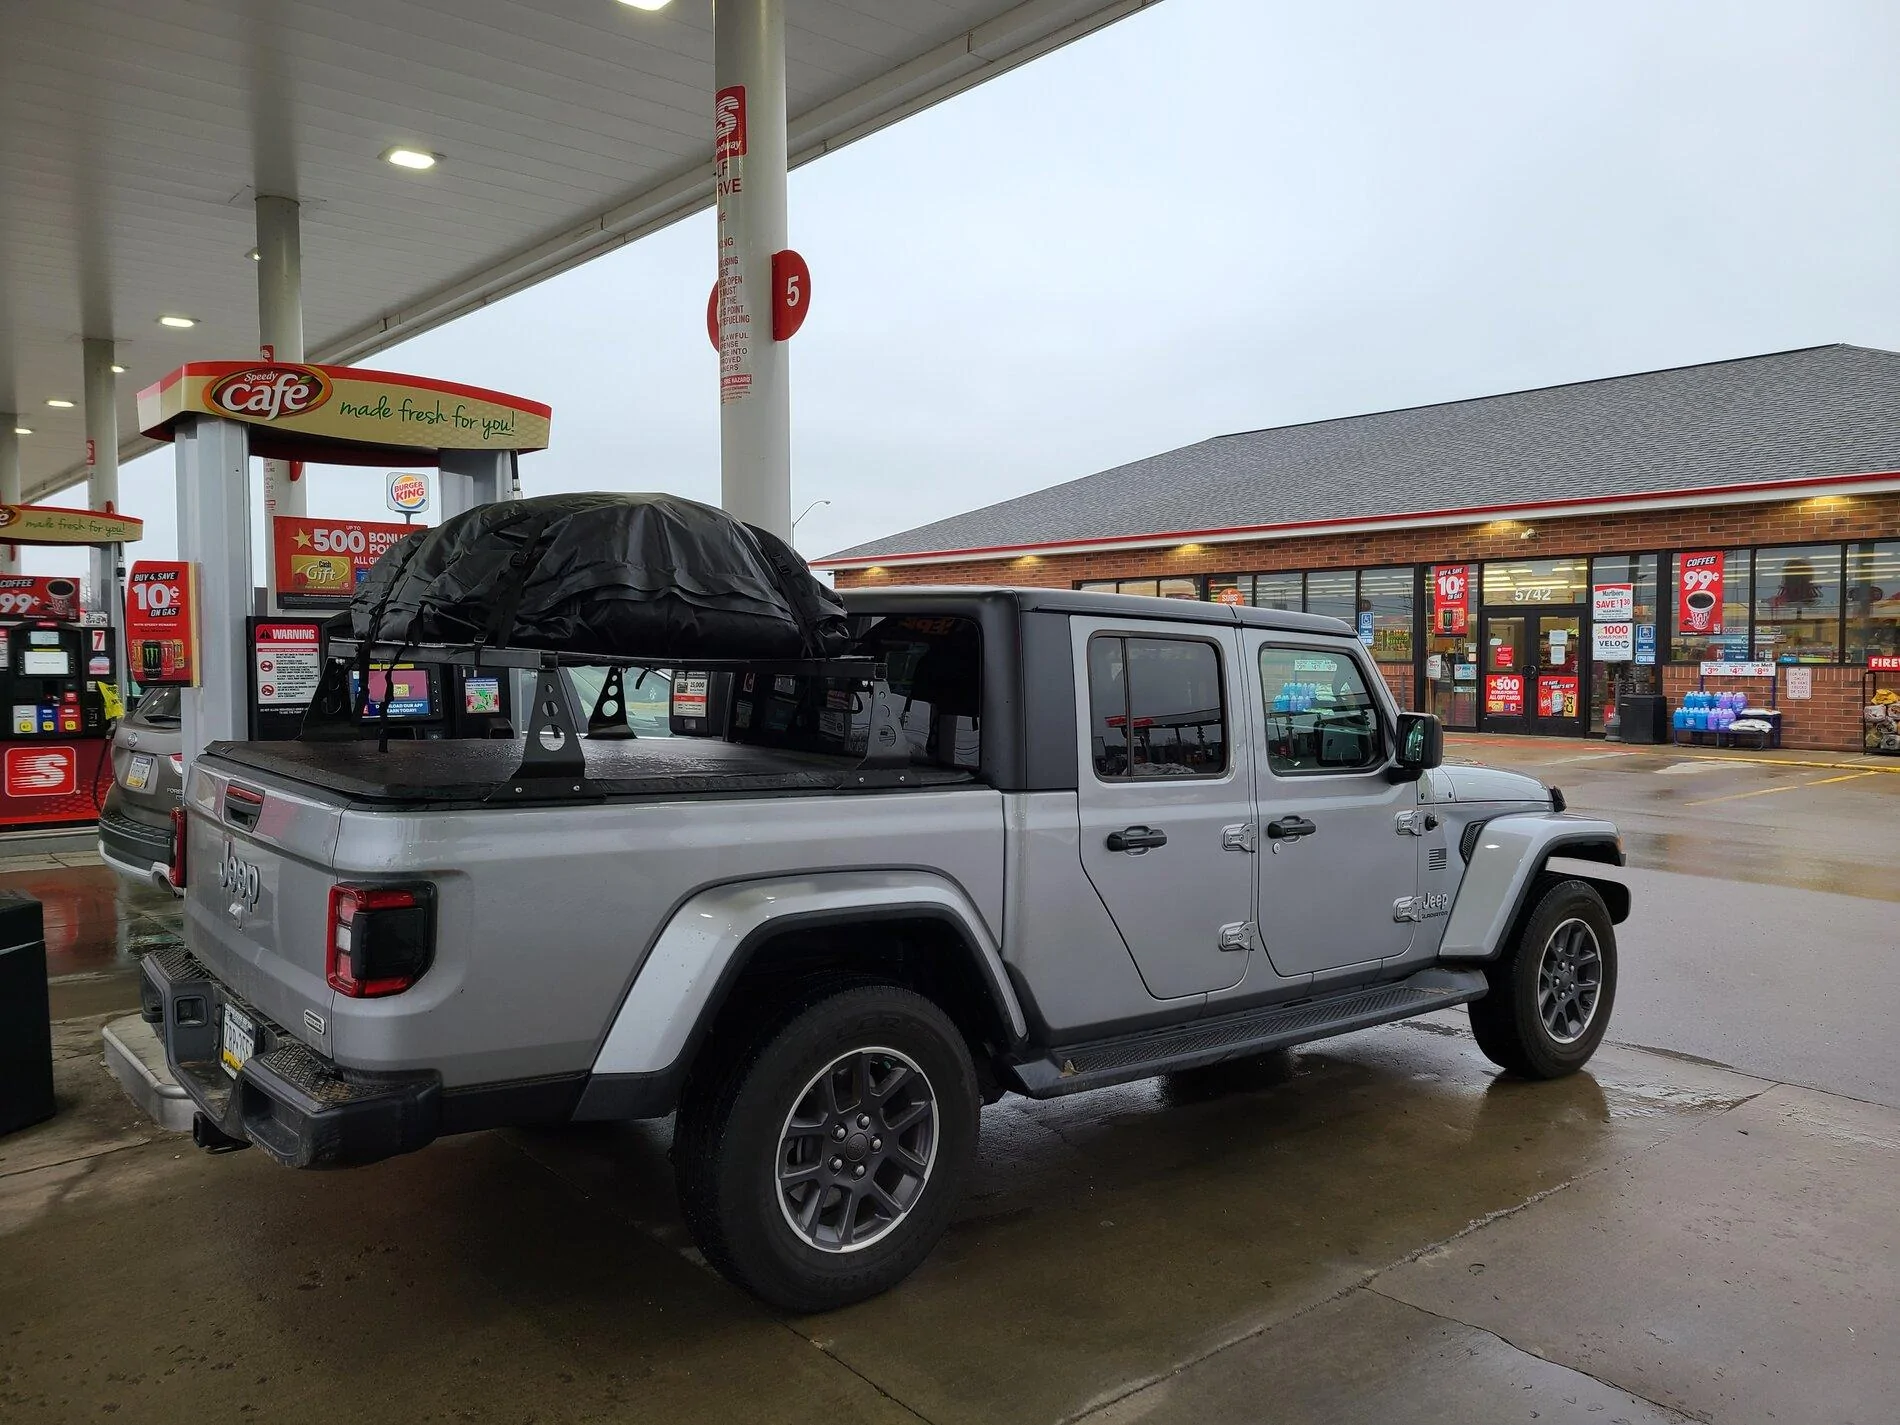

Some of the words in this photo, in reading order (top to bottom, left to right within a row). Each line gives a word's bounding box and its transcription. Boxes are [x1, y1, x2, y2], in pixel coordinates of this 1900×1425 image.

[717, 139, 742, 155] edway
[718, 160, 729, 178] LF
[718, 178, 742, 198] RVE
[786, 275, 800, 307] 5
[244, 371, 279, 384] Speedy
[340, 395, 393, 421] made
[398, 398, 449, 425] fresh
[451, 405, 479, 432] for
[482, 411, 516, 440] you!
[394, 481, 424, 493] BURGER
[395, 488, 425, 502] KING
[89, 521, 103, 533] for
[313, 528, 366, 553] 500
[354, 557, 368, 566] ALL
[1686, 556, 1716, 567] COFFEE
[134, 574, 148, 582] BUY
[157, 572, 176, 580] SAVE
[307, 565, 336, 584] Gift
[1452, 567, 1464, 575] SAVE
[1454, 592, 1464, 600] GAS
[1514, 588, 1552, 601] 5742
[1596, 600, 1616, 608] SAVE
[150, 609, 163, 617] ON
[164, 608, 178, 616] GAS
[272, 629, 315, 641] WARNING
[1603, 625, 1628, 635] 1000
[94, 631, 104, 650] 7
[1871, 658, 1900, 669] FIRE
[1496, 679, 1520, 691] 500
[1566, 696, 1574, 713] C4
[218, 841, 260, 913] Jeep
[1421, 892, 1449, 910] Jeep
